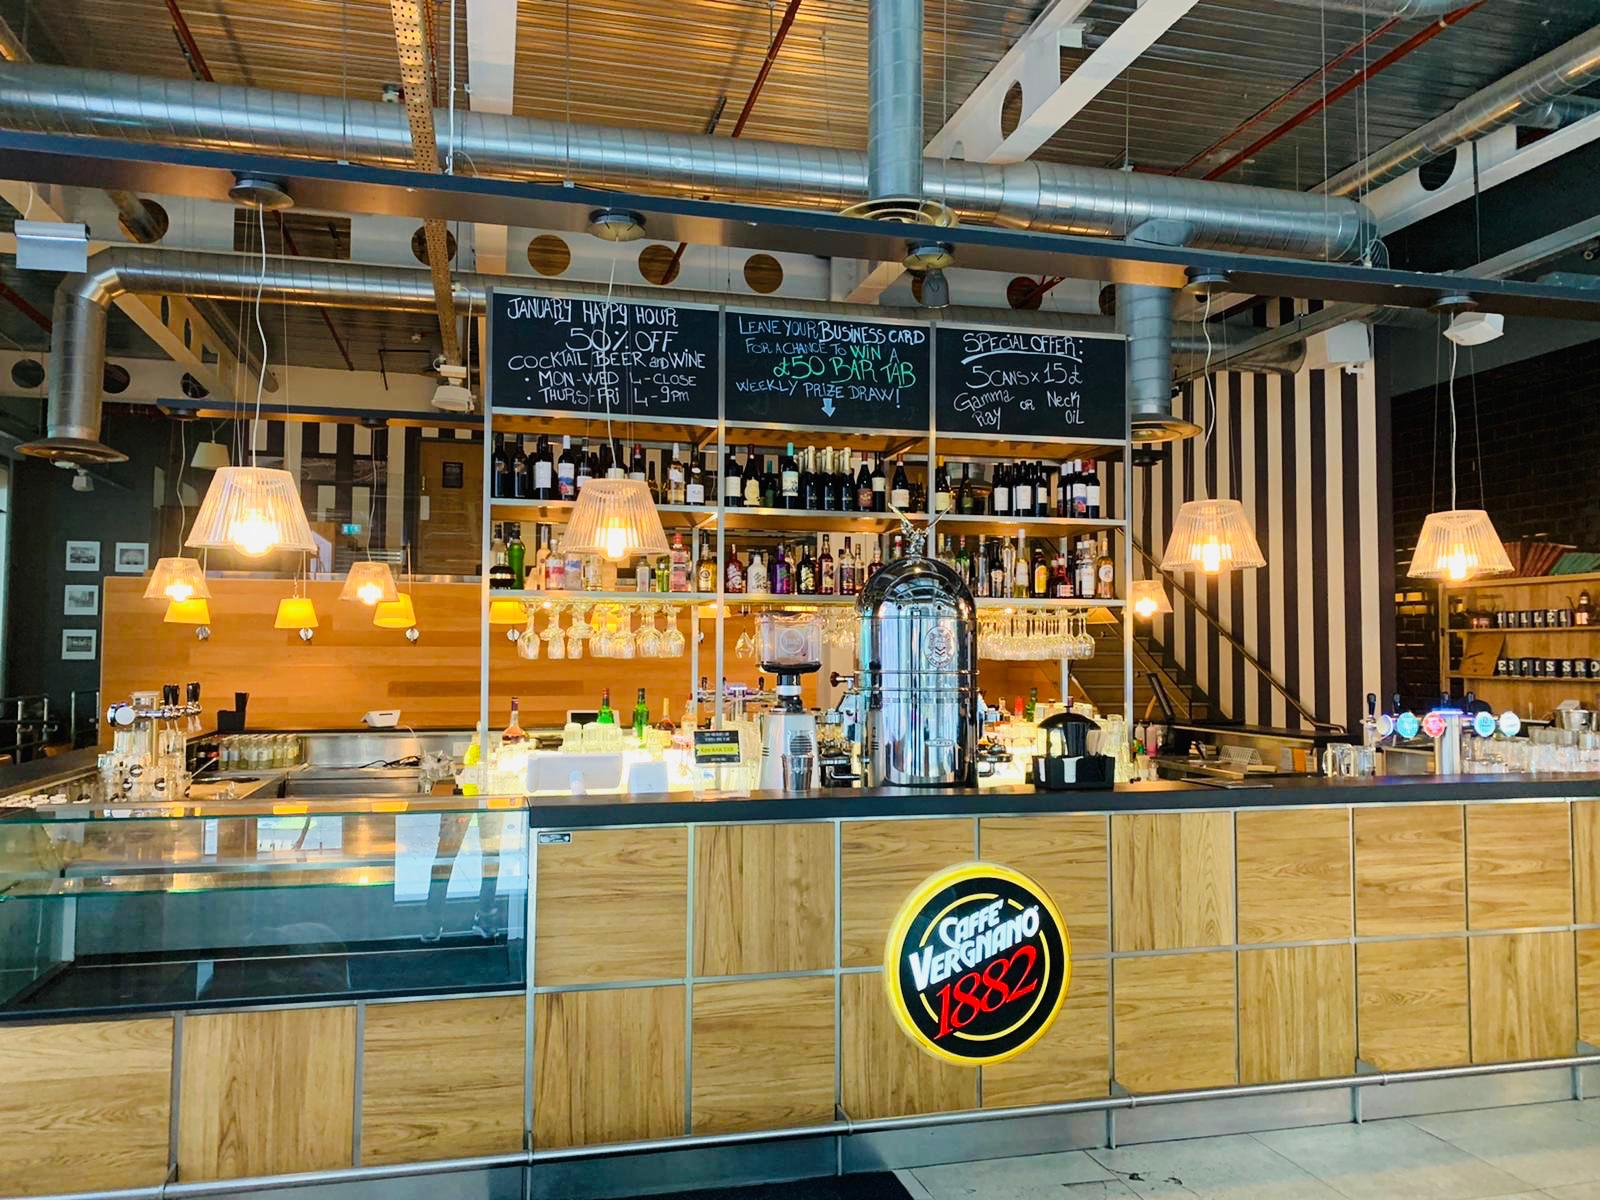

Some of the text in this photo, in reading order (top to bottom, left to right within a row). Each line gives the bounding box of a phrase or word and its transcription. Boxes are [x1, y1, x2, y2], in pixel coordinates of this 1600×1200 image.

[507, 297, 679, 327] JANUARY HAPPY HOUR
[566, 328, 679, 353] 50% OFF
[739, 315, 925, 345] LEAVE YOUR BUSINESS CARD
[745, 337, 772, 354] FOR
[783, 342, 828, 355] CHANCE
[830, 344, 847, 356] TO
[850, 344, 882, 361] WIN
[889, 348, 900, 363] A
[963, 332, 1084, 357] SPECIAL OFFER:
[508, 350, 588, 370] COCKTAIL
[593, 351, 647, 367] BEER
[668, 349, 706, 369] WINE
[773, 355, 916, 389] £50 BAR TAB
[736, 378, 900, 409] WEEKLY PRIZE DRAW!
[953, 389, 1015, 412] Gamma
[1046, 390, 1080, 409] Neck
[971, 406, 1001, 430] Ray
[908, 907, 1040, 992] VERGNANO
[934, 944, 1038, 1040] 1882
